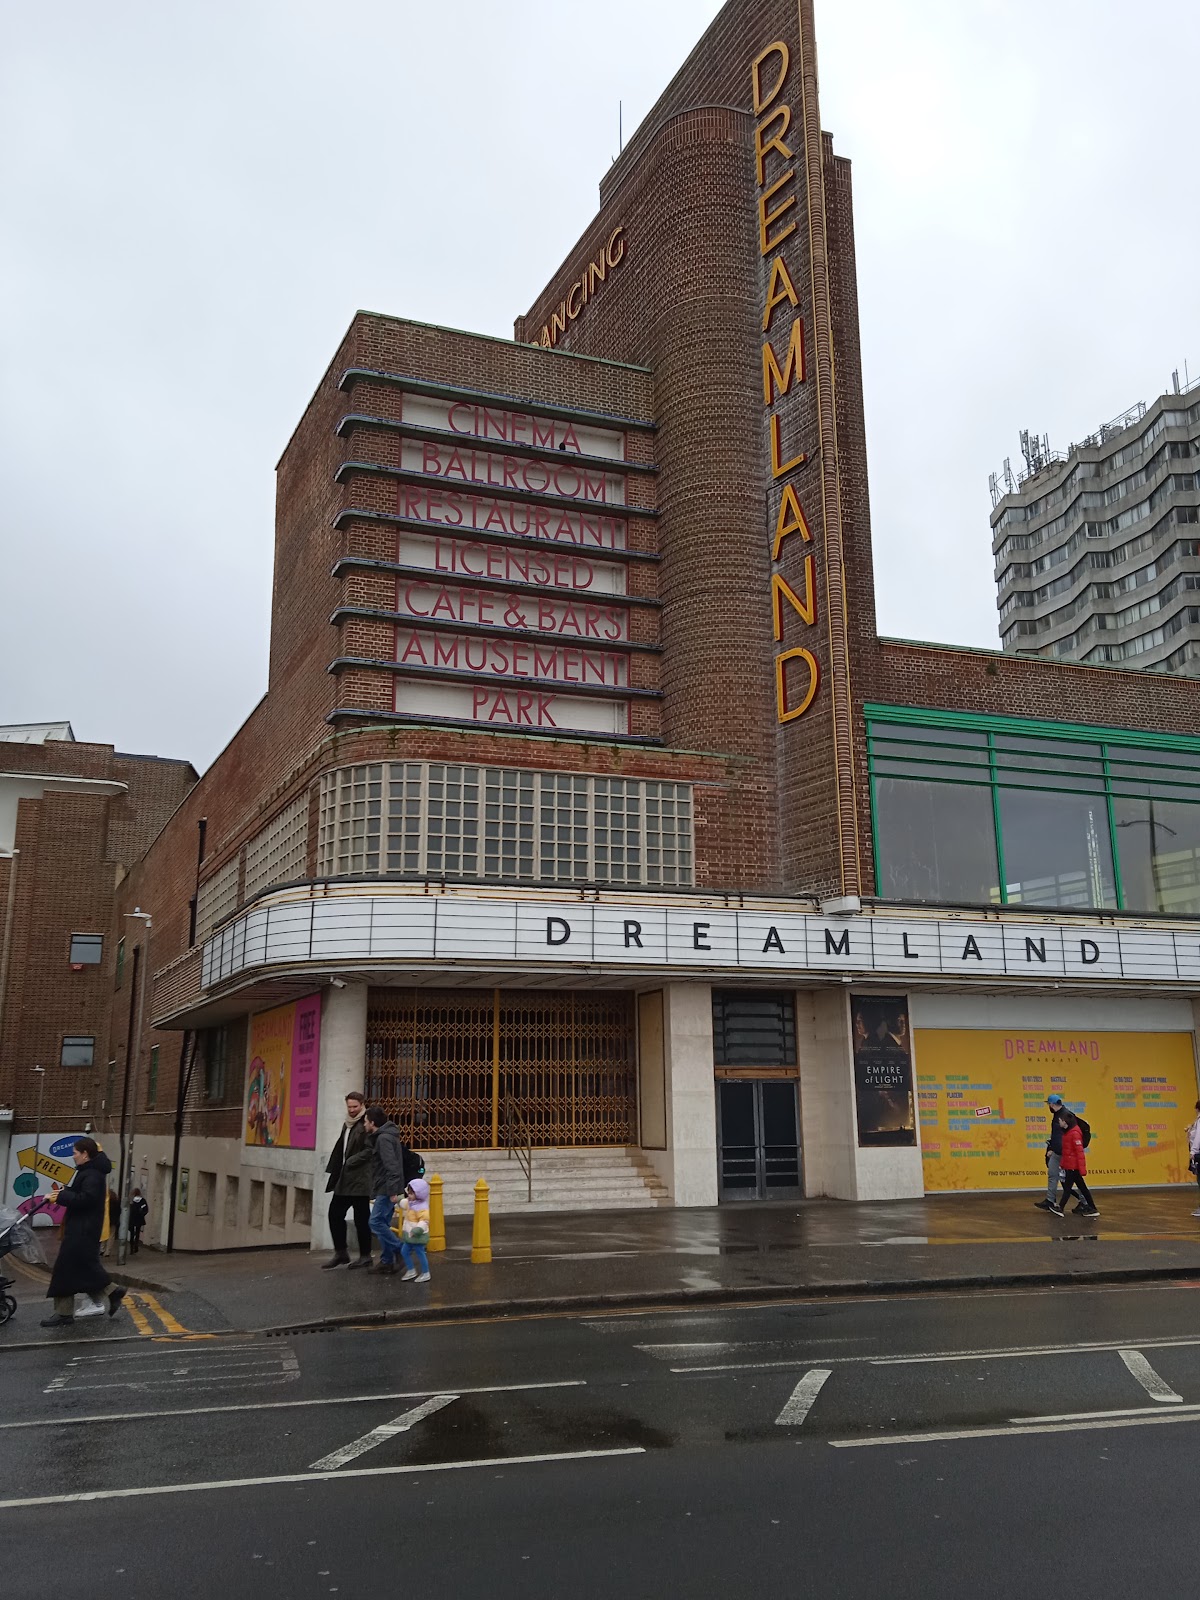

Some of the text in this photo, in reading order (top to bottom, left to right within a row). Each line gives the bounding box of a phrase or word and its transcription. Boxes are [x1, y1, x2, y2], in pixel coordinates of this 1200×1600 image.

[530, 226, 624, 347] ANCING
[752, 41, 819, 724] DREAMLAND
[447, 402, 582, 454] CINEMA
[422, 442, 606, 502] BALLROOM
[404, 485, 622, 549] RESTAURANT
[434, 537, 594, 590] LICENSED
[404, 581, 622, 641] CAFE & BARS
[401, 629, 623, 686] AMUSEMENT
[472, 686, 557, 727] PARK
[546, 916, 1100, 965] DREAMLAND
[866, 1066, 901, 1074] EMPIRE
[1005, 1039, 1099, 1061] DREAMLAND
[875, 1076, 904, 1084] LIGHT
[37, 1158, 61, 1176] FREE
